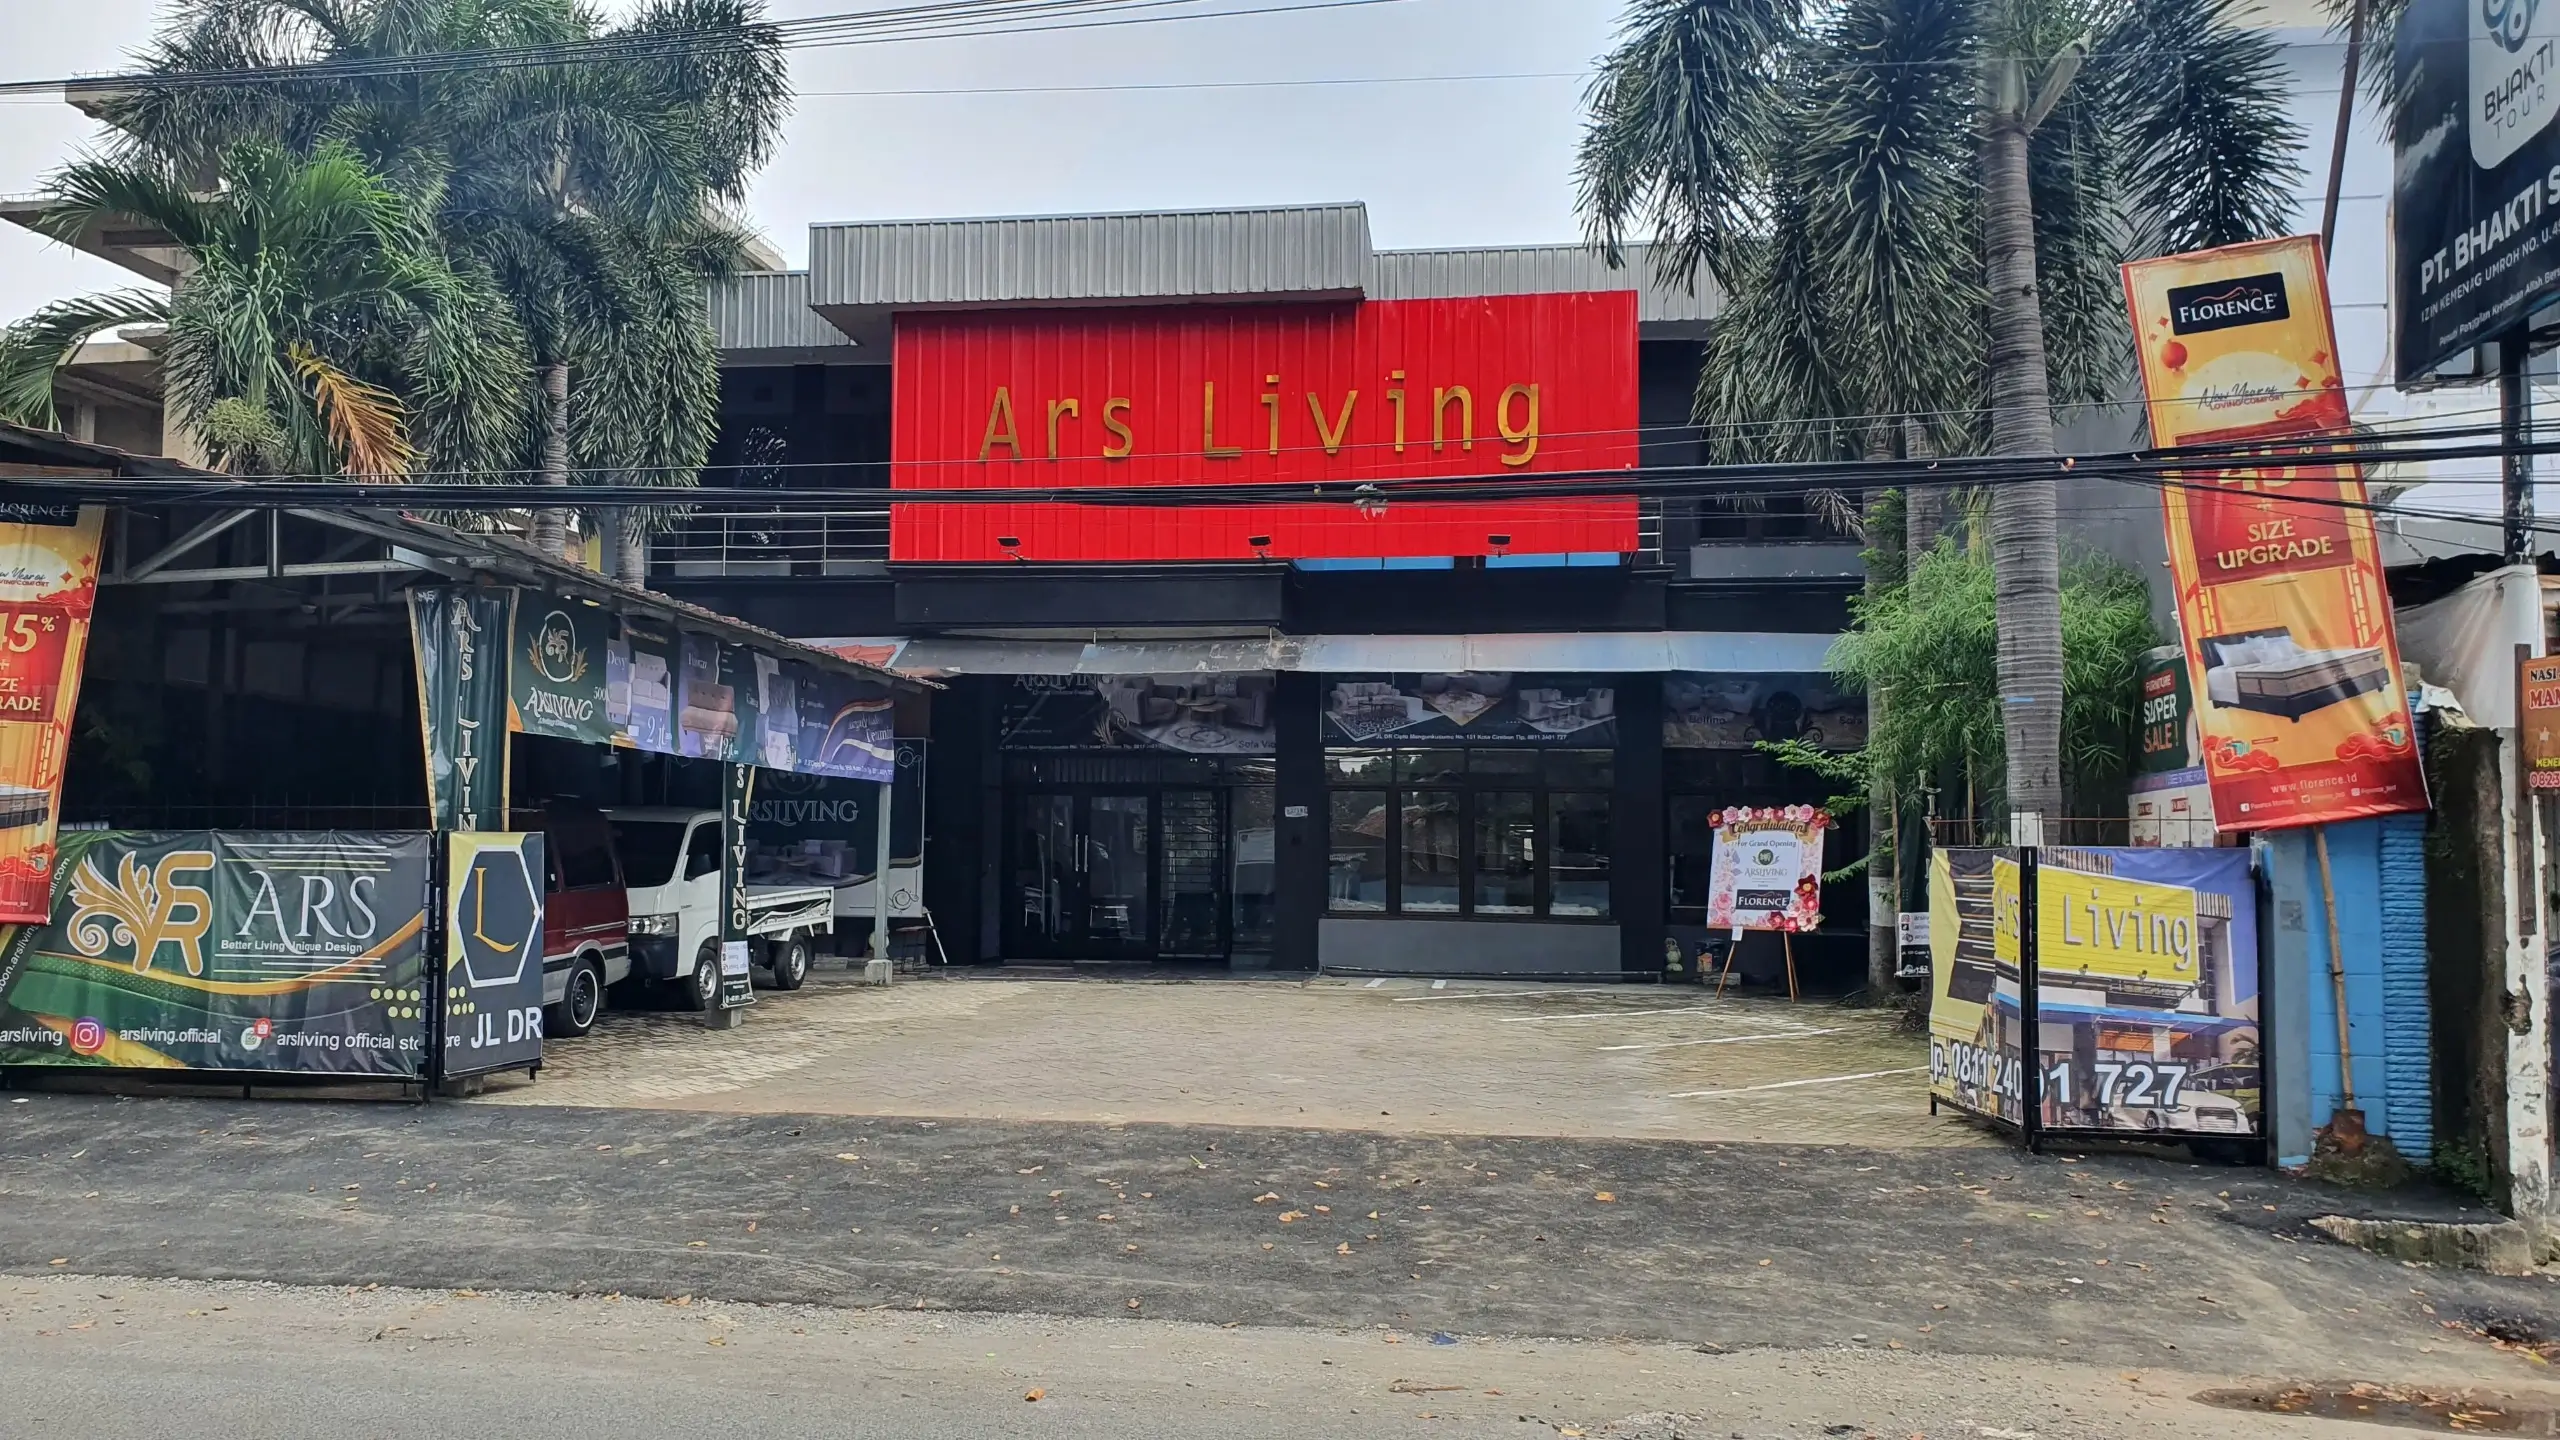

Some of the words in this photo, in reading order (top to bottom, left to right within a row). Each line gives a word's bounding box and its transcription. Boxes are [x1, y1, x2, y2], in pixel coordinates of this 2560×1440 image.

[2484, 40, 2554, 122] BHAKTI
[2493, 84, 2546, 139] TOUR
[2421, 247, 2451, 295] PT.
[2454, 179, 2542, 271] BHAKTI
[2421, 302, 2439, 323] IZIN
[2439, 272, 2483, 311] KEMENAG
[2485, 247, 2520, 281] UMROH
[2522, 236, 2540, 258] NO.
[2178, 293, 2277, 323] FLORENCE
[978, 386, 1134, 462] Ars
[1204, 370, 1539, 465] Living
[2248, 518, 2297, 543] SIZE
[2216, 536, 2334, 569] UPGRADE
[2145, 674, 2171, 692] FURNITURE
[2530, 667, 2557, 682] NASI
[2143, 693, 2178, 725] SUPER
[235, 869, 377, 954] ARS
[472, 867, 520, 953] L
[1737, 896, 1789, 907] FLORENCE
[221, 939, 252, 950] Better
[254, 940, 285, 953] Living
[329, 941, 363, 953] Design
[2063, 888, 2192, 971] Living
[0, 1029, 63, 1046] arsliving
[119, 1028, 221, 1045] arsliving.official
[276, 1031, 339, 1051] arsliving
[344, 1032, 395, 1050] official
[470, 1012, 501, 1049] JL
[507, 1006, 543, 1043] DR
[1951, 1041, 1990, 1088] 0811
[2094, 1064, 2187, 1106] 727
